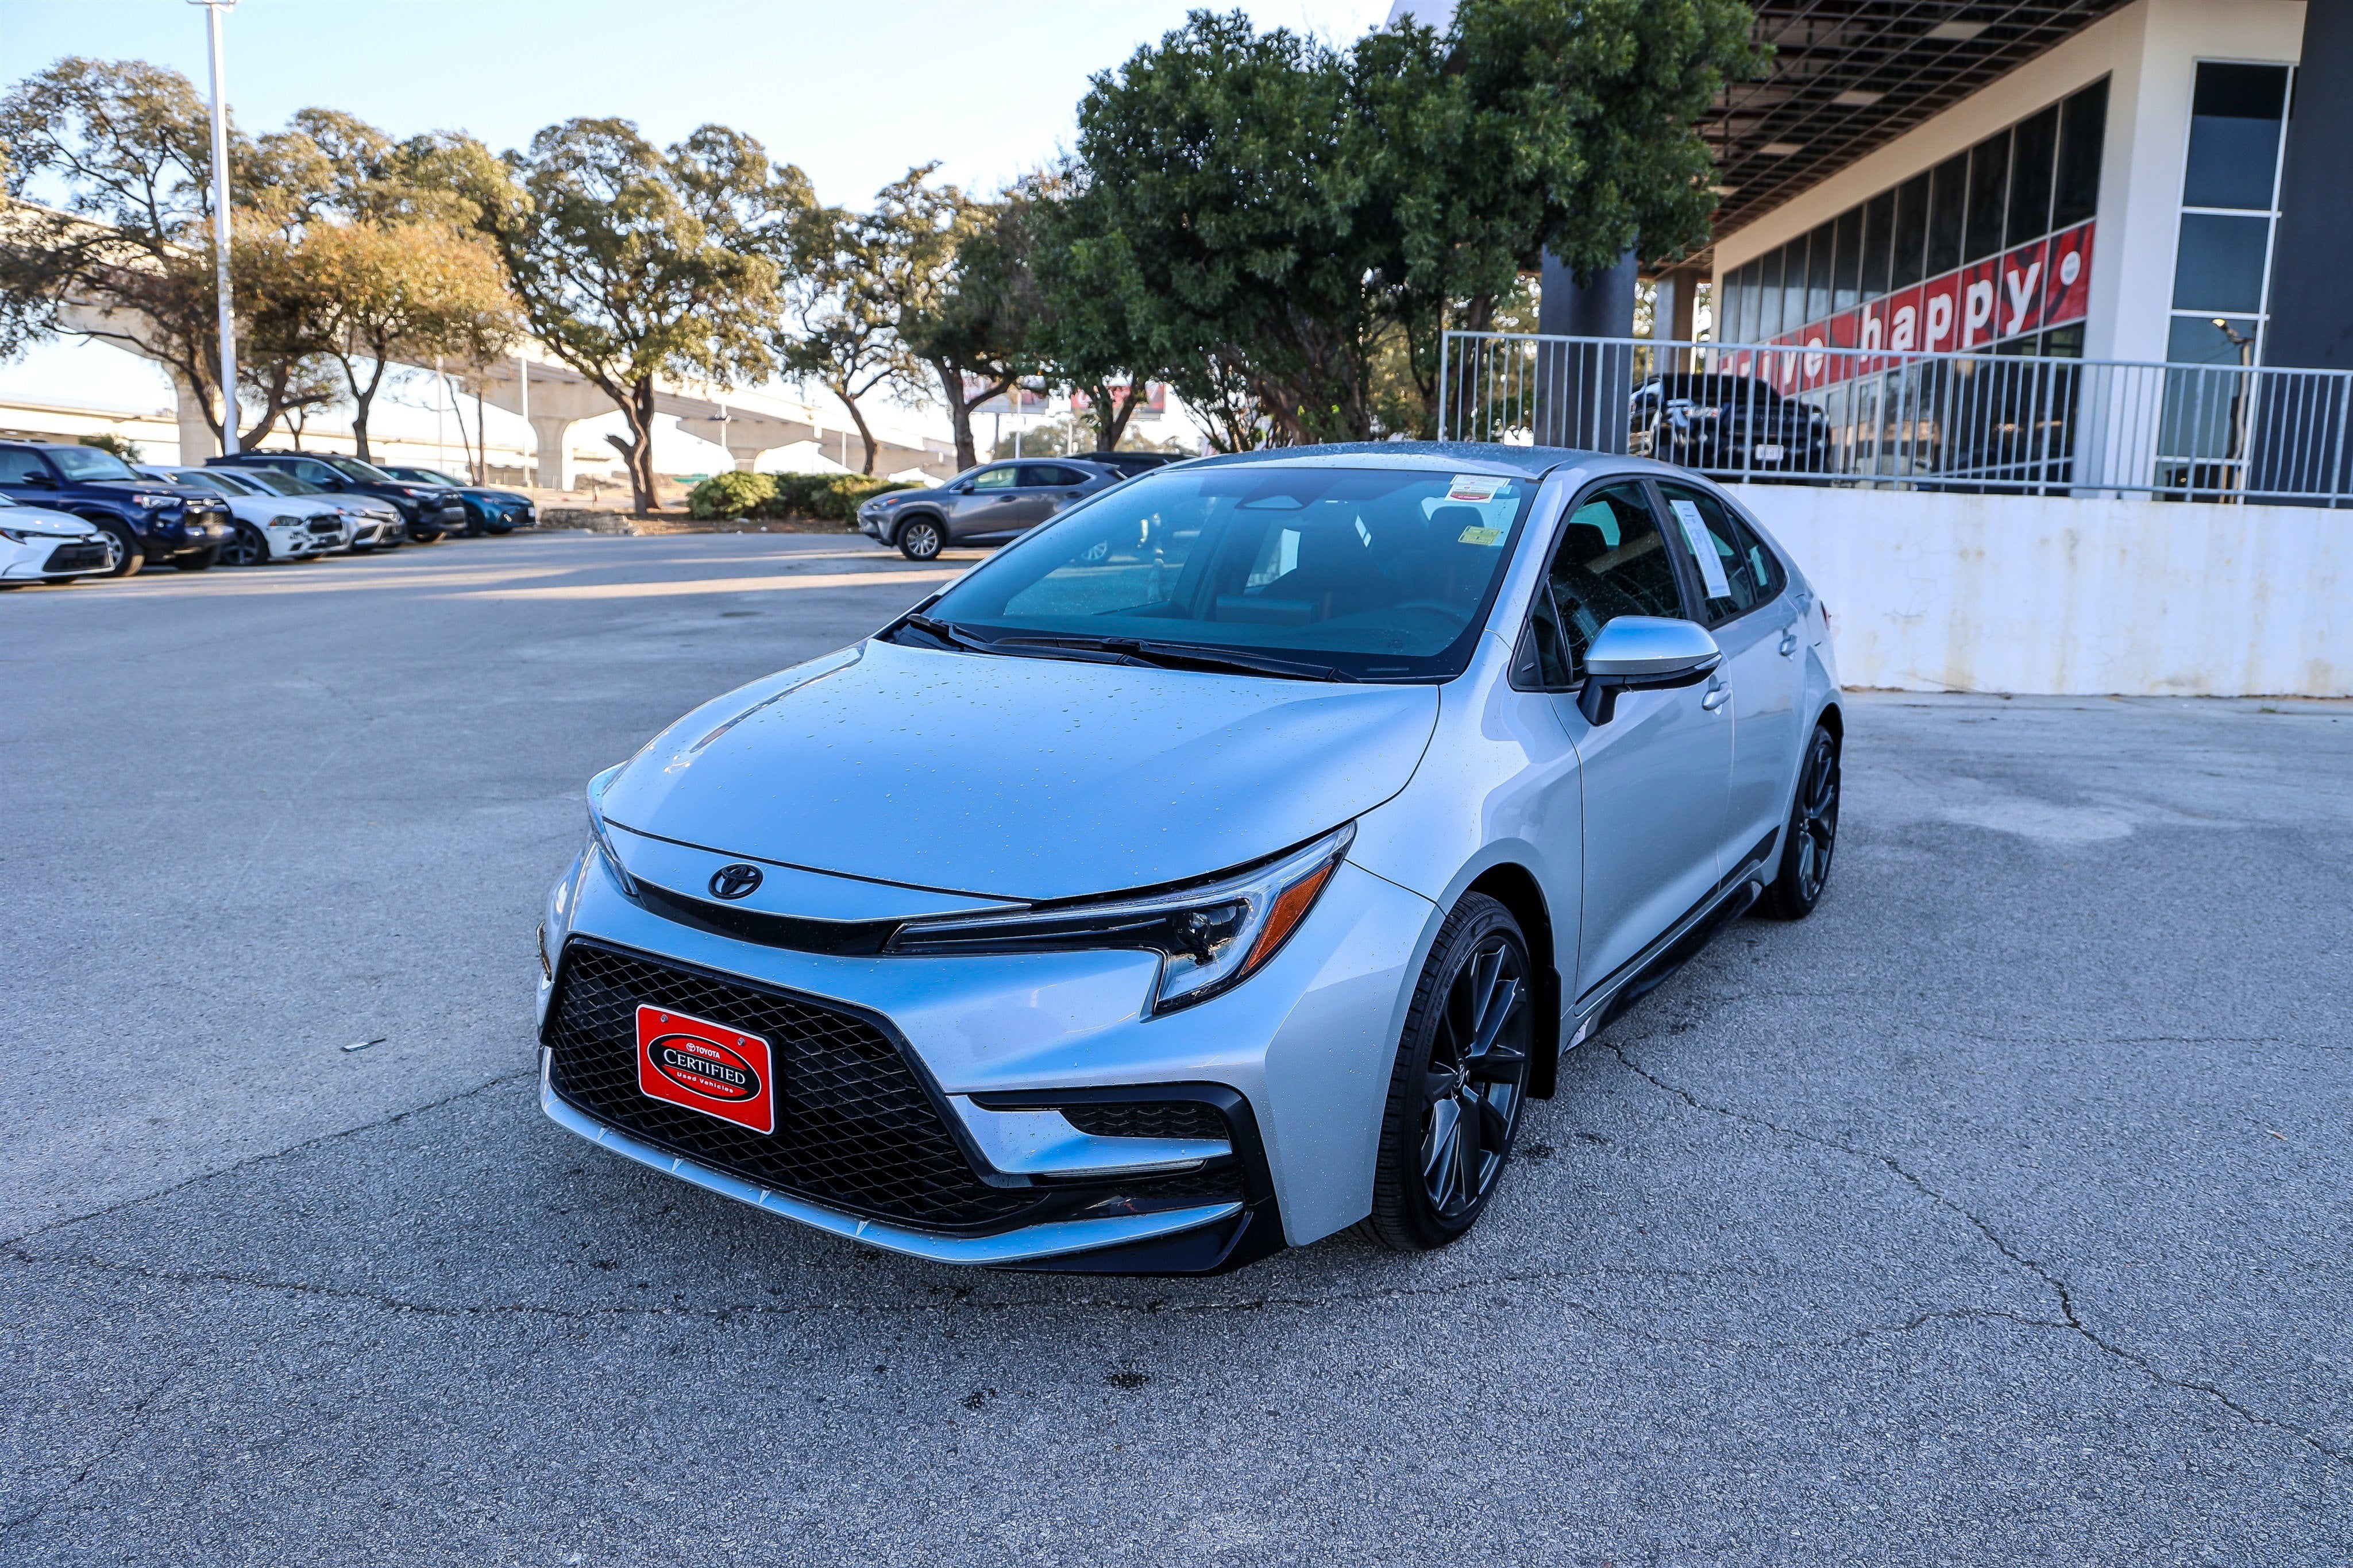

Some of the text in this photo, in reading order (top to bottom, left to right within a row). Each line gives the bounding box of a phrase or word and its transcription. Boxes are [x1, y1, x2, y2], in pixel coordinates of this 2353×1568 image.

[1860, 261, 2042, 361] happy
[663, 1049, 746, 1084] CERTIFIED
[696, 1046, 720, 1059] TOYOTA
[677, 1072, 734, 1093] Used Vehicles
